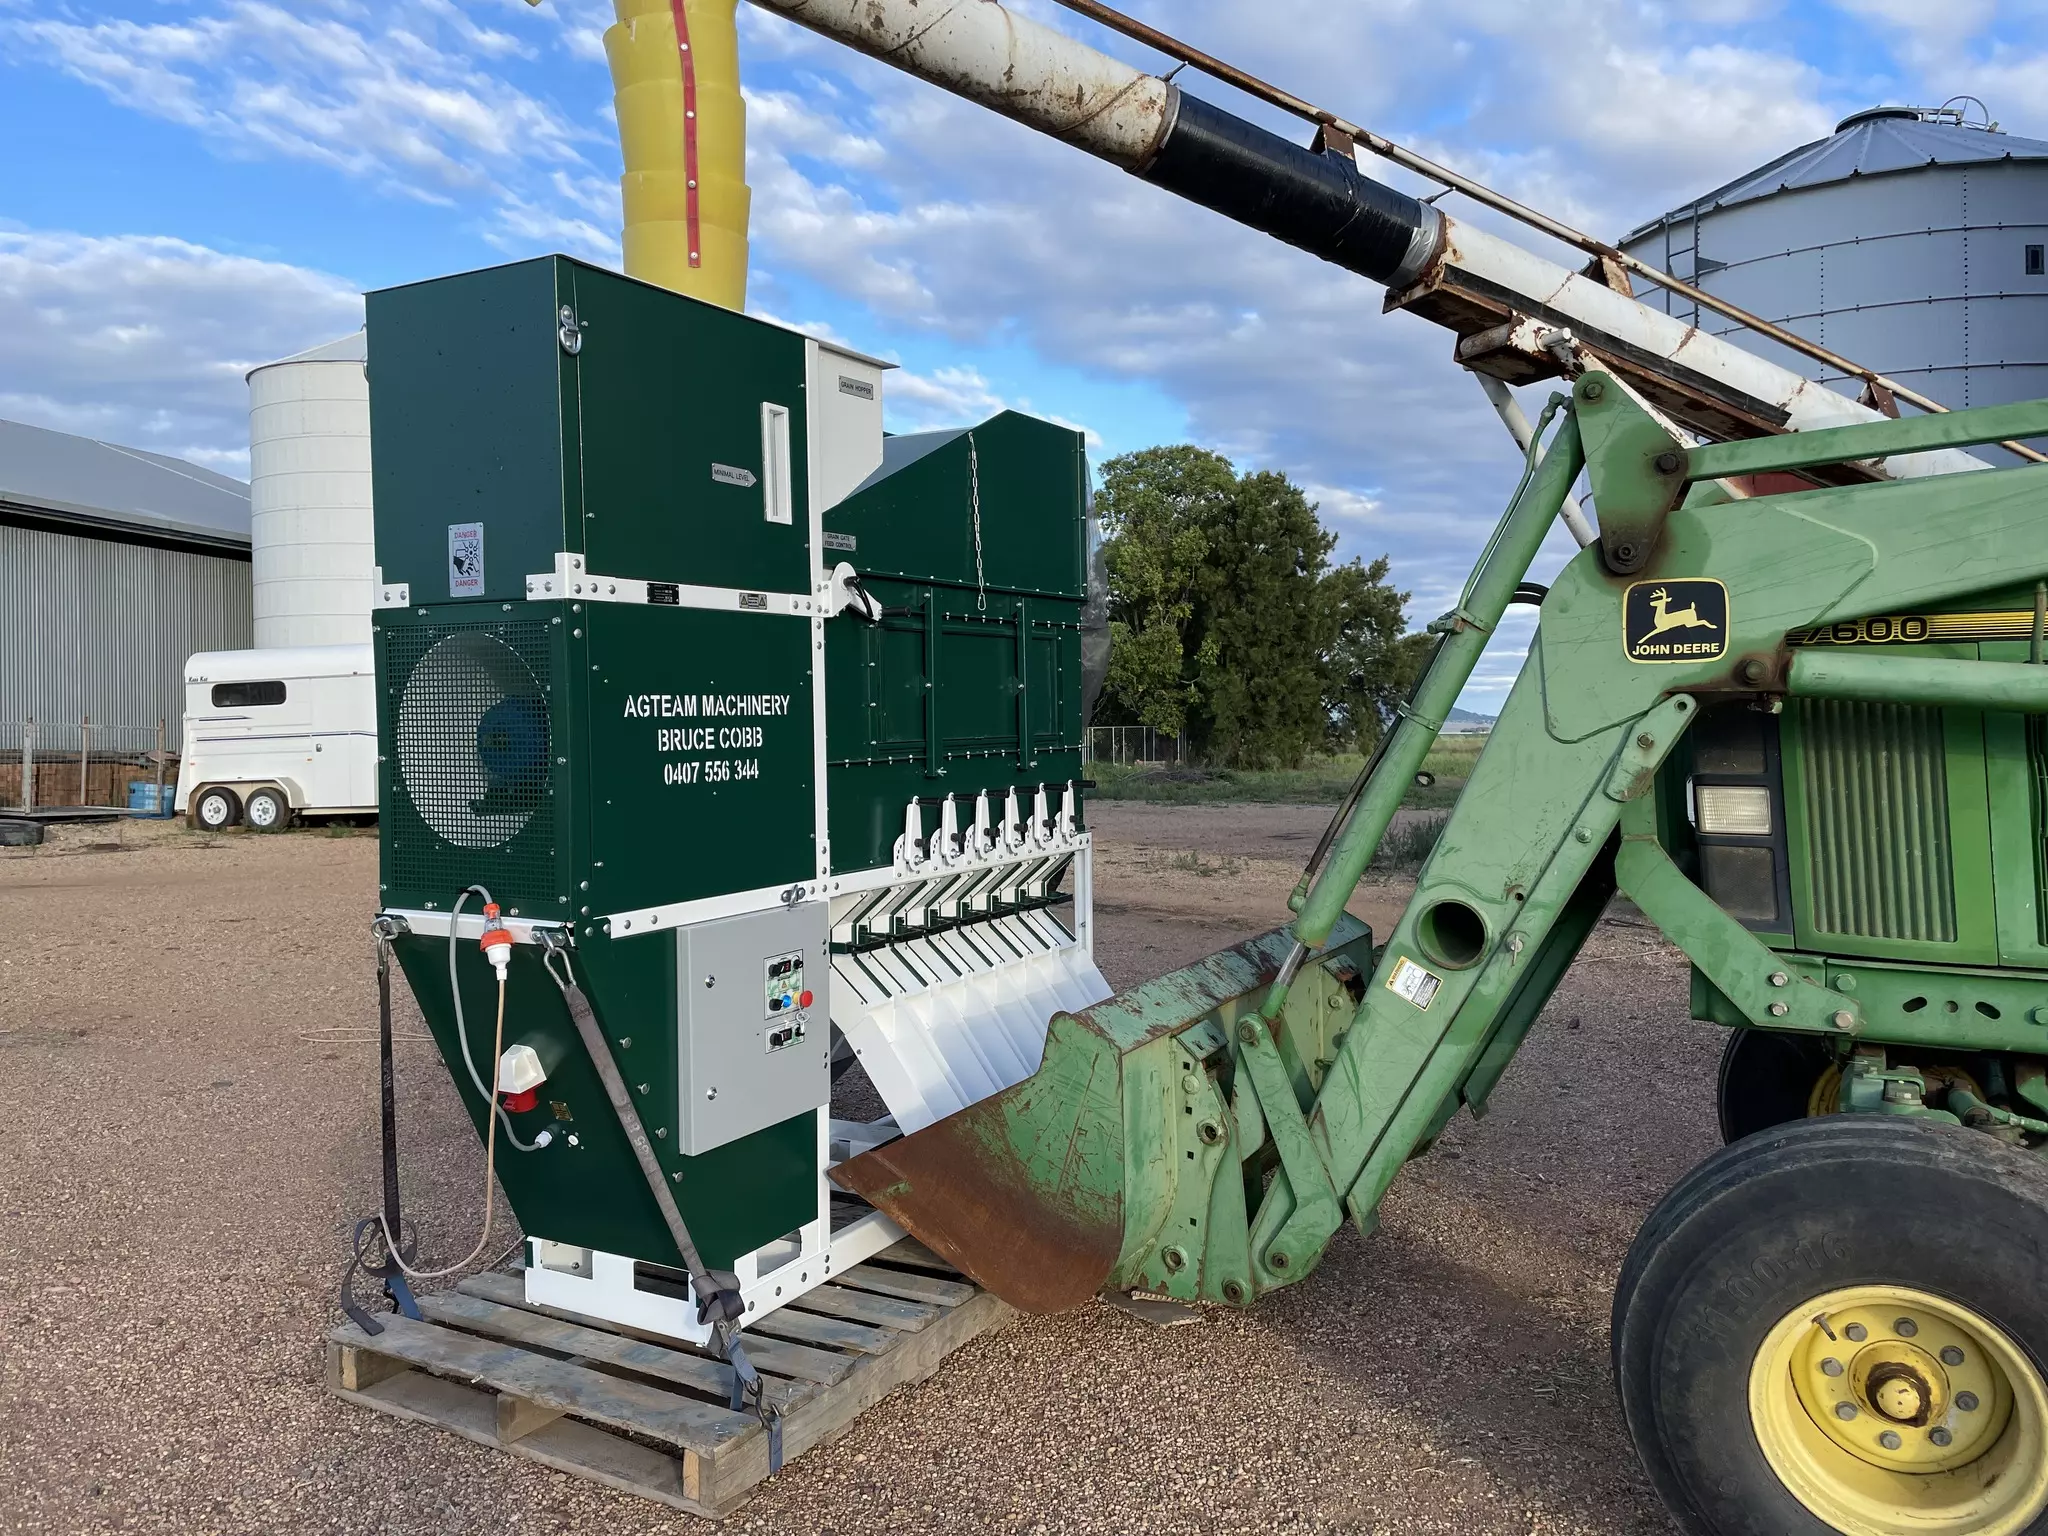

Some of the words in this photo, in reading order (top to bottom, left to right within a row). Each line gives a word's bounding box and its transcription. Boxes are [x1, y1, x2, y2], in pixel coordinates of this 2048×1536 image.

[841, 381, 854, 390] GRAIN
[855, 386, 871, 395] HOPPER
[713, 468, 735, 479] MINIMAL
[735, 473, 749, 482] LEVEL
[454, 530, 477, 539] DANGER
[835, 541, 852, 549] CONTROL
[455, 579, 478, 587] DANGER
[1632, 644, 1670, 655] JOHN
[1673, 643, 1720, 654] DEERE
[623, 694, 697, 718] AGTEAM
[702, 694, 790, 717] MACHINERY
[657, 727, 715, 751] BRUCE
[719, 726, 763, 749] COBB
[664, 761, 700, 785] 0407
[704, 760, 730, 782] 556
[734, 758, 759, 780] 344
